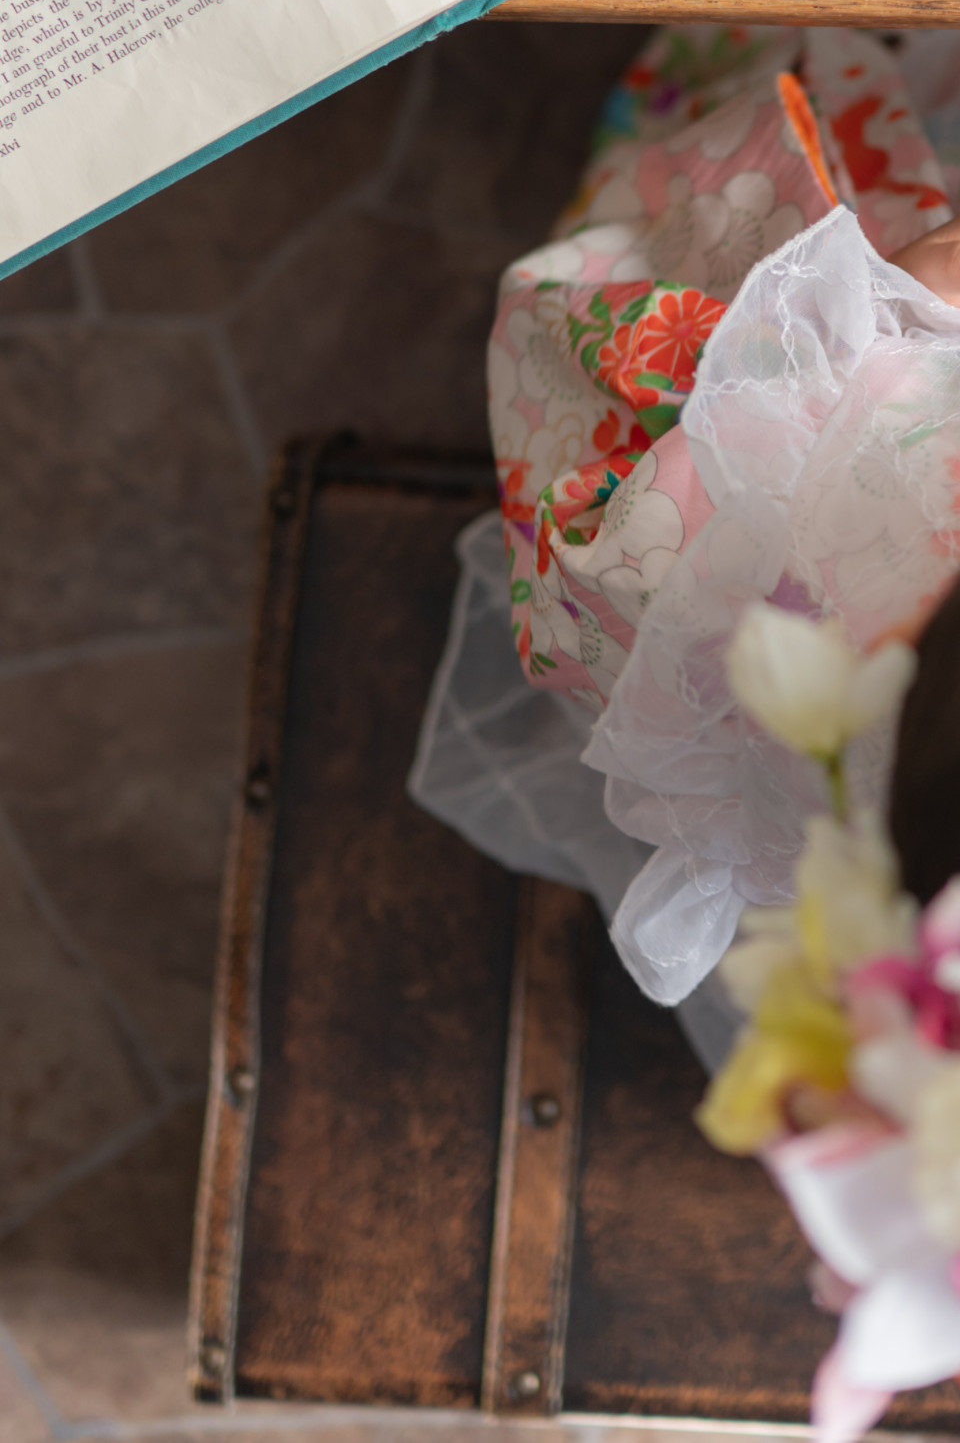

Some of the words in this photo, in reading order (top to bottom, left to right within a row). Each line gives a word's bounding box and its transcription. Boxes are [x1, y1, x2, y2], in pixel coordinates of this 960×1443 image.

[0, 72, 10, 83] I
[12, 63, 31, 78] am
[32, 31, 79, 69] grateful
[81, 26, 94, 37] to
[93, 0, 135, 27] Trinity
[2, 13, 44, 42] depicts
[21, 94, 45, 115] and
[46, 88, 60, 99] to
[62, 74, 87, 89] Mr.
[91, 62, 104, 74] A.
[105, 30, 164, 64] Halcrow,
[163, 14, 184, 36] the
